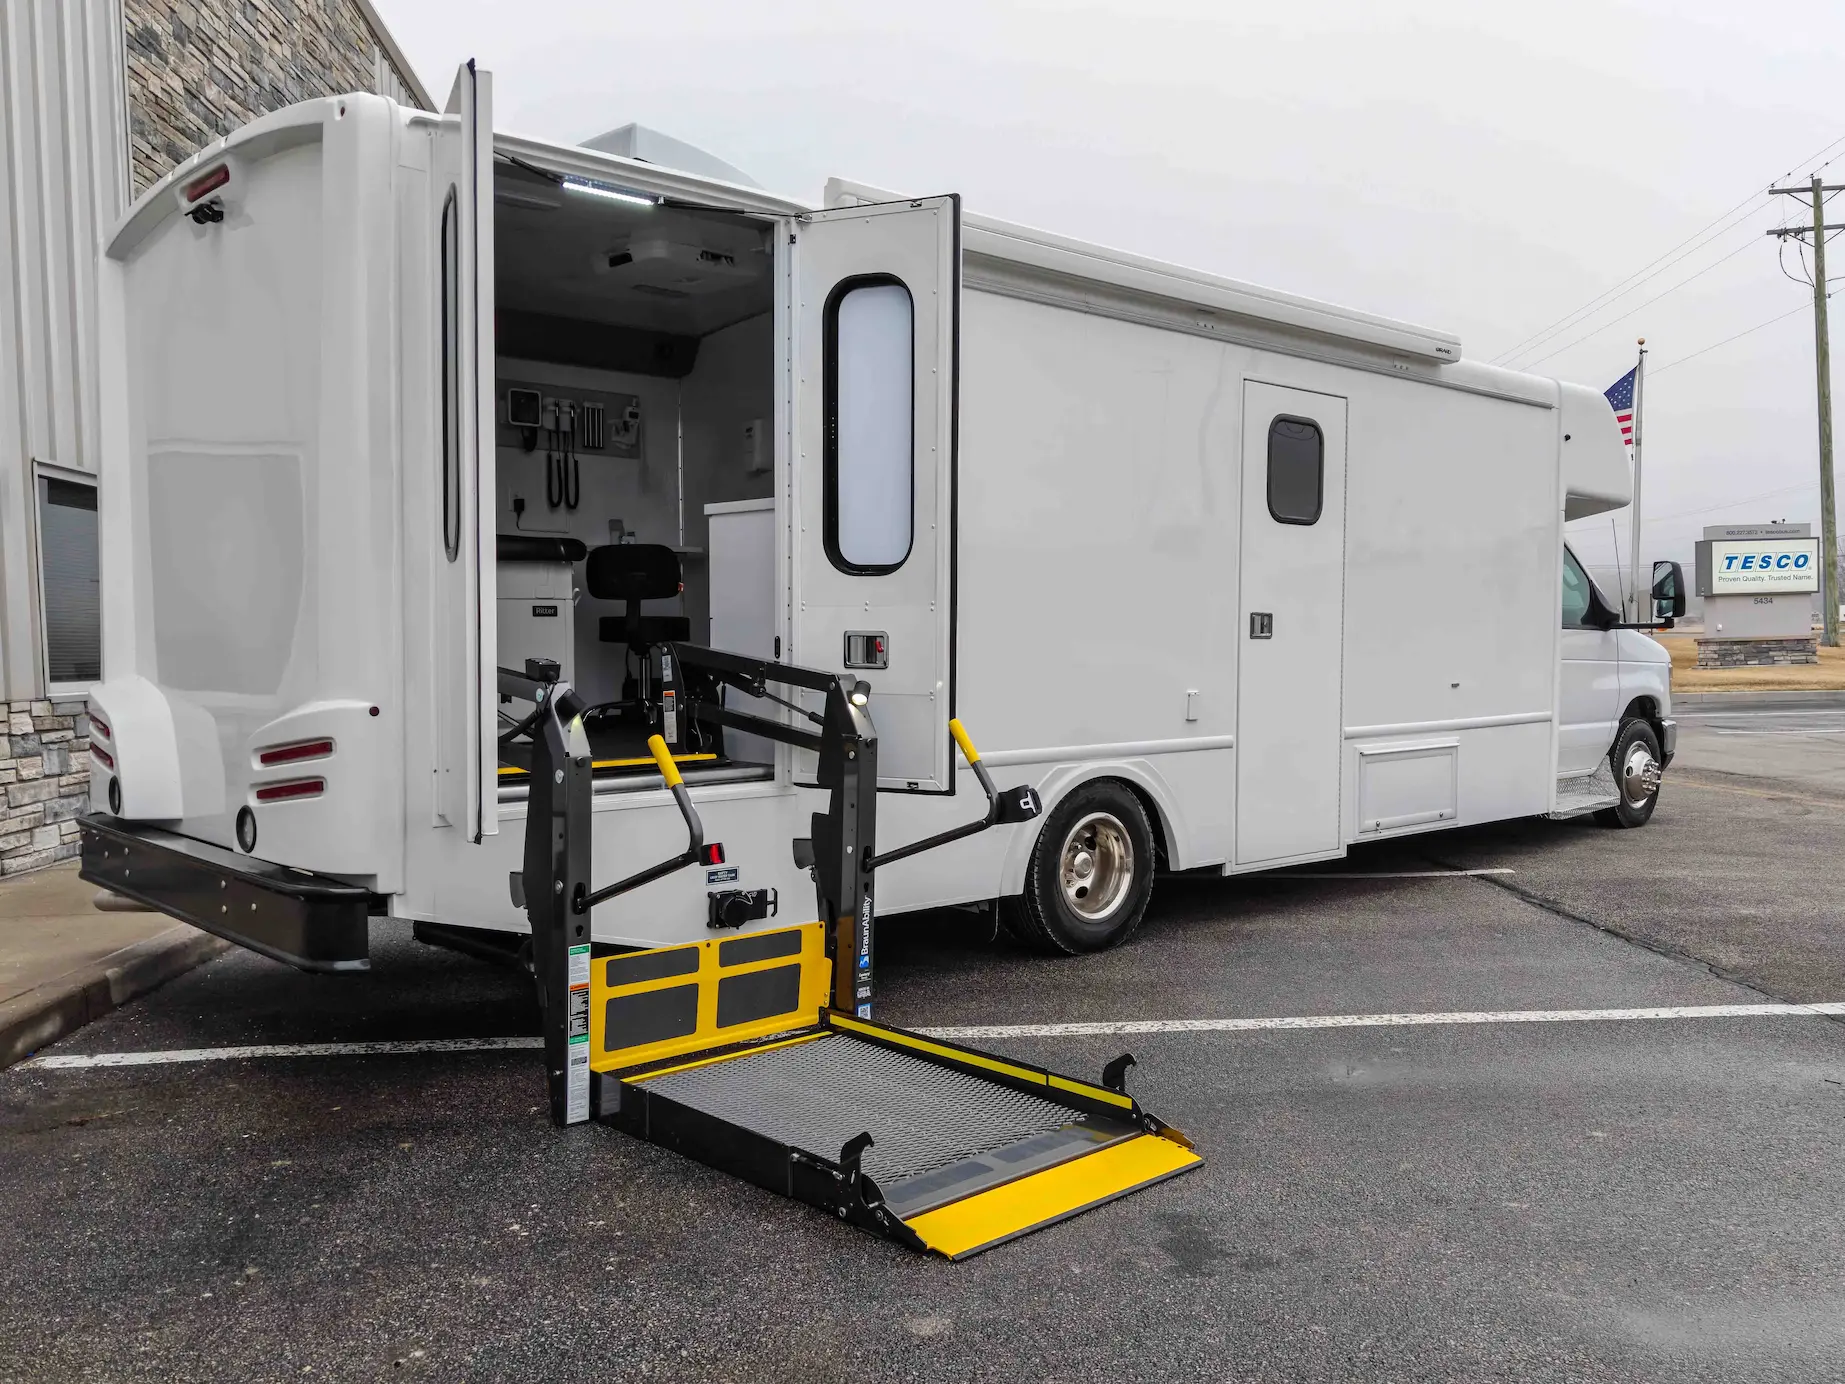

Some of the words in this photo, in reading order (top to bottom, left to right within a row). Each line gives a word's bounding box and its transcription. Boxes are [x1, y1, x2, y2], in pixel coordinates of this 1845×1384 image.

[1725, 554, 1809, 570] TESCO
[535, 607, 555, 615] Ritter
[861, 895, 872, 956] BraunAbility
